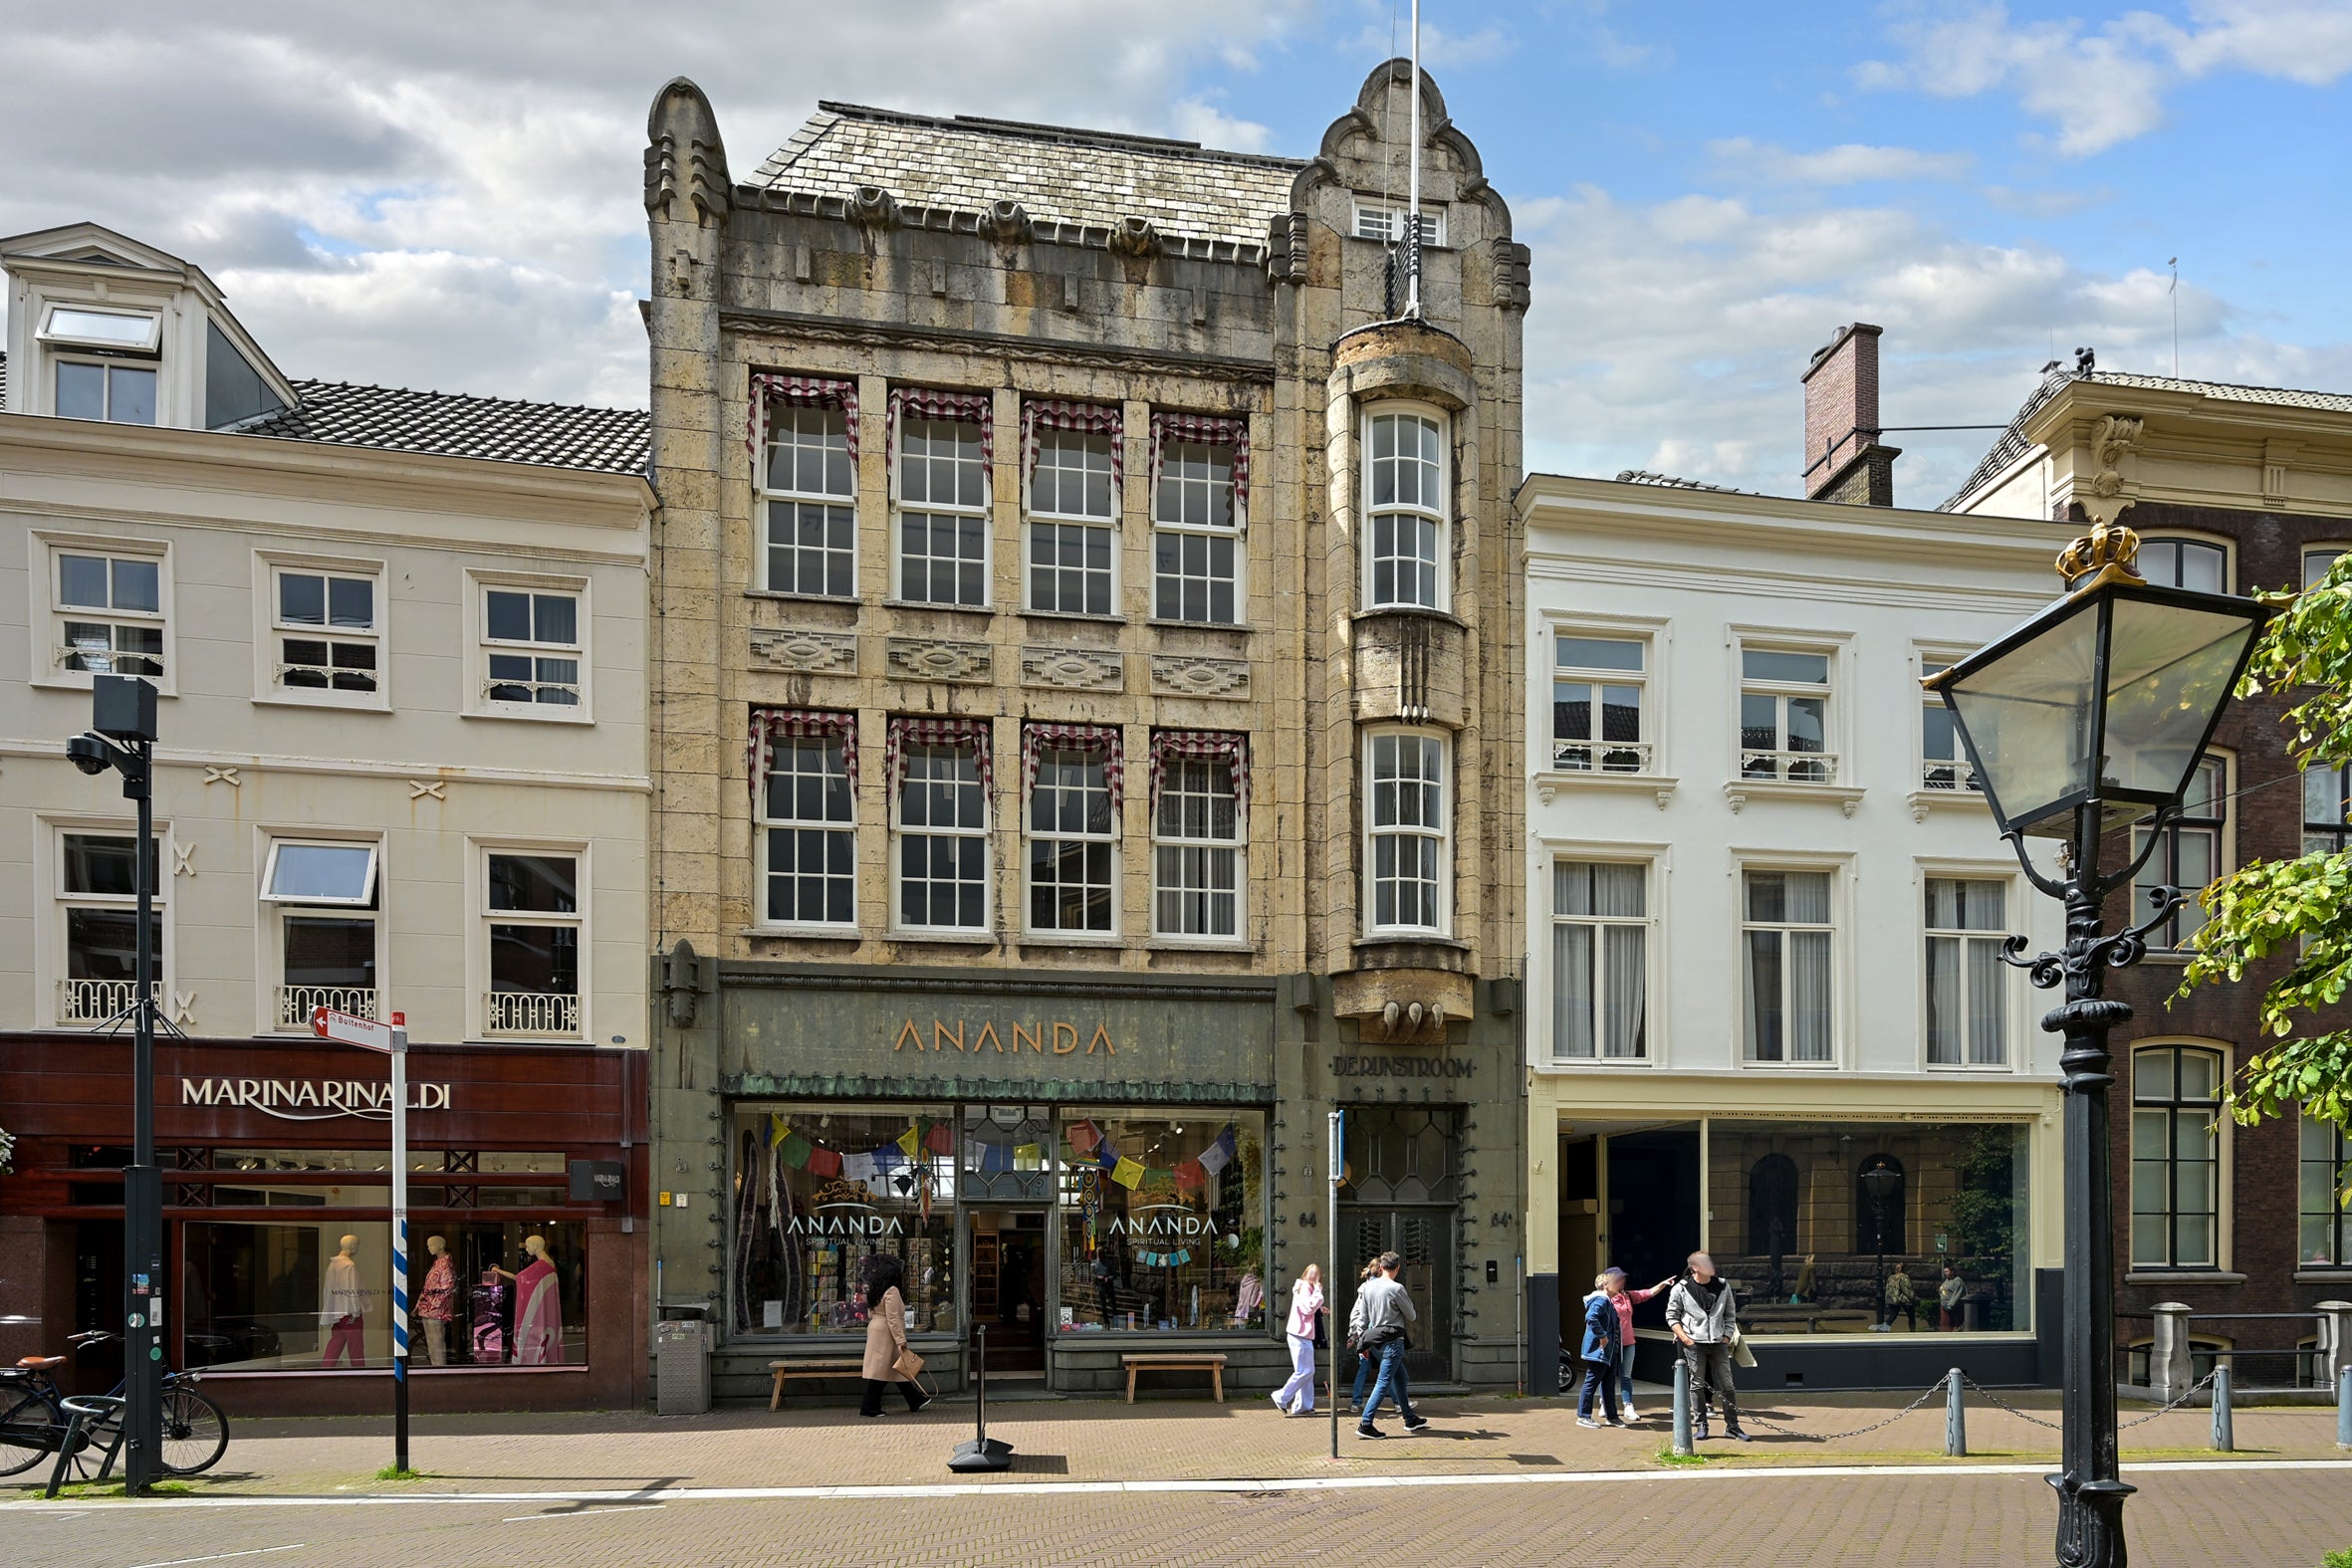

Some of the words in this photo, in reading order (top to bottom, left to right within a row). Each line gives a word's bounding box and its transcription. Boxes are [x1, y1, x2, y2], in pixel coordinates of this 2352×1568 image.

[338, 1015, 374, 1032] Buitenhof
[894, 1018, 1116, 1055] ANANDA
[787, 1215, 904, 1234] ANANDA
[1109, 1216, 1218, 1234] ANANDA
[1298, 1212, 1316, 1228] 64
[806, 1237, 850, 1246] SPIRITUAL
[854, 1237, 885, 1246] LIVING
[1126, 1237, 1170, 1246] SPIRITUAL
[1172, 1237, 1201, 1246] LIVING
